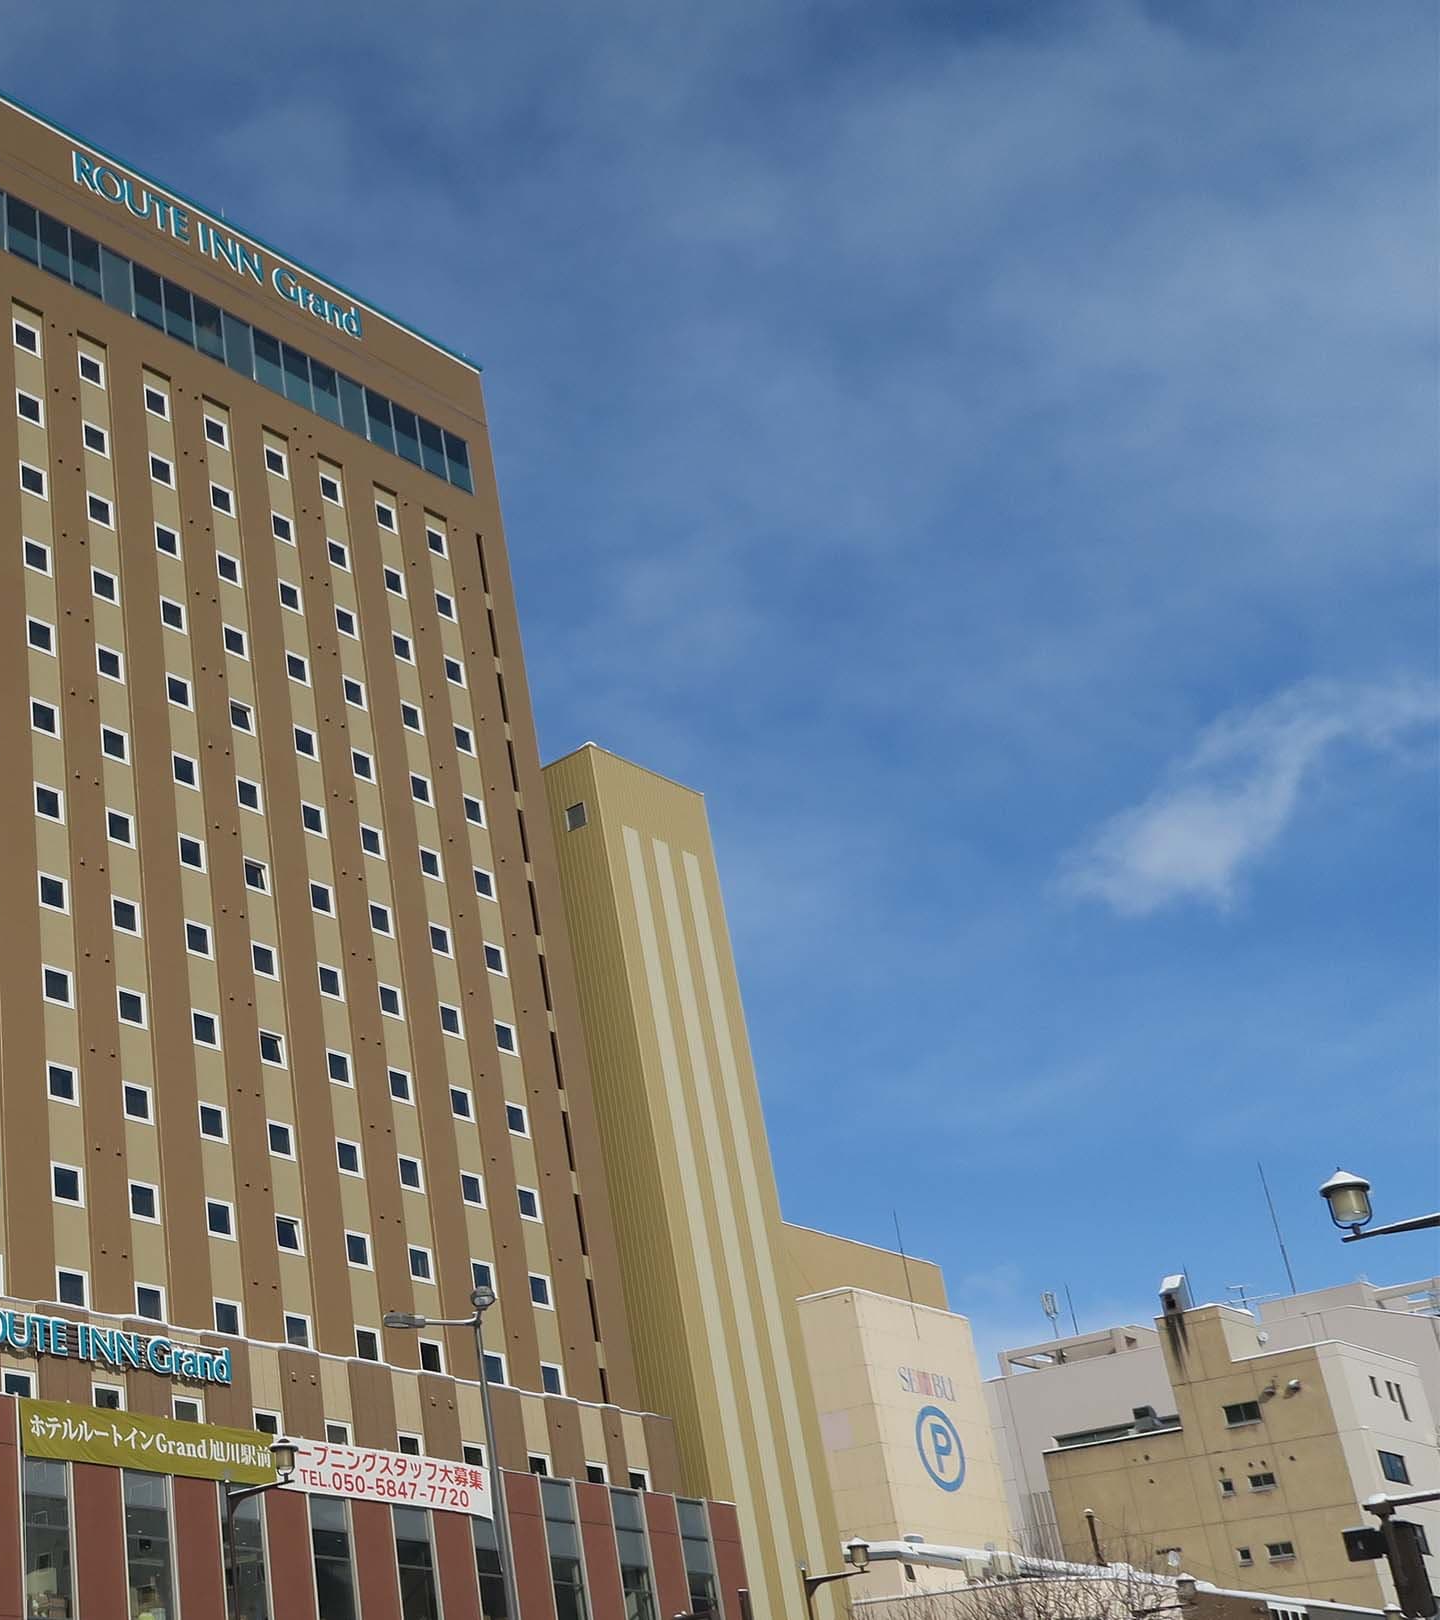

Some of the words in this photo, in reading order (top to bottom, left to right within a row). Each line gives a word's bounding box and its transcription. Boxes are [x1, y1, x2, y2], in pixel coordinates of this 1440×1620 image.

[71, 150, 191, 245] ROUTE
[197, 220, 264, 287] INN
[272, 267, 363, 340] Grand
[77, 1322, 141, 1369] INN
[147, 1336, 232, 1385] Grand
[298, 1446, 484, 1491] ープニングスタッフ大募集
[930, 1422, 952, 1474] P
